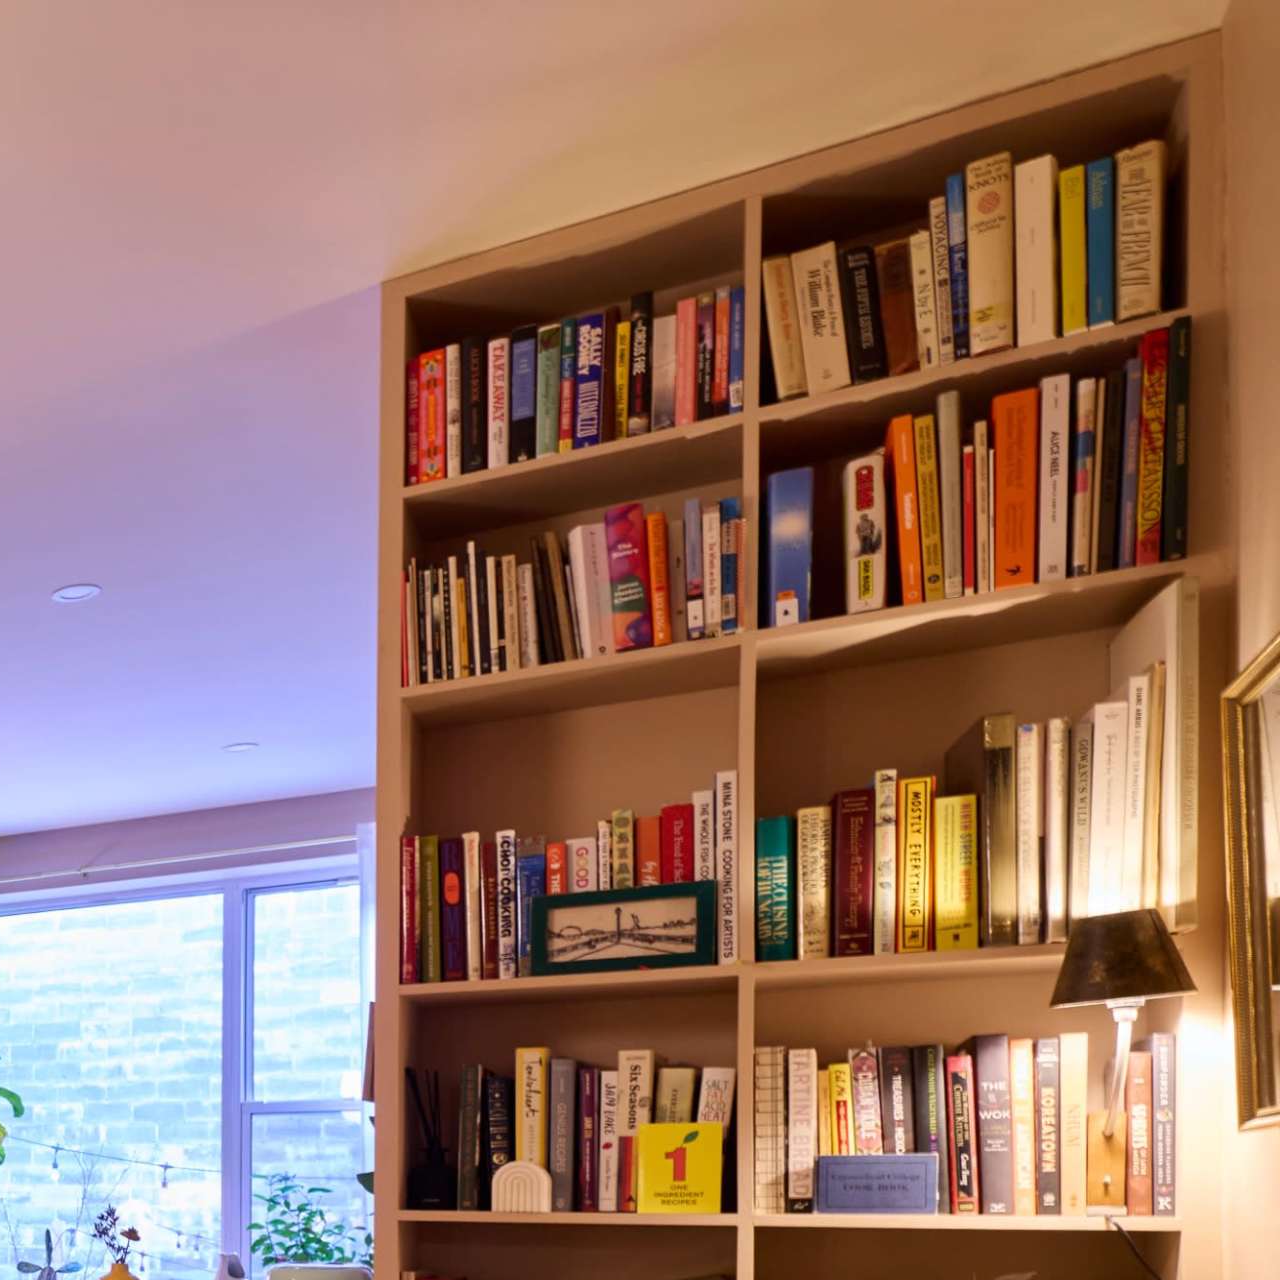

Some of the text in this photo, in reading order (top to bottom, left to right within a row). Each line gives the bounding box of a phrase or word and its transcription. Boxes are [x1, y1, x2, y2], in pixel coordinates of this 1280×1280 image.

[969, 174, 1009, 192] KNOTS
[1121, 181, 1152, 216] YEAR
[934, 212, 947, 277] VOYAGING
[1120, 231, 1152, 287] FRENCH
[807, 269, 826, 338] William Blake
[856, 288, 870, 315] FIFTH
[577, 324, 590, 375] ROONEY
[590, 327, 602, 366] SALLY
[493, 344, 505, 423] TAKEAWAY
[577, 381, 600, 437] INTERMEZZO
[1050, 431, 1060, 478] ALICE NEEL
[1141, 416, 1164, 538] KJARTANSSON
[1077, 739, 1088, 826] GOWANUS WILD
[673, 819, 682, 835] The
[700, 803, 709, 816] THE
[700, 819, 709, 845] WHOLE
[722, 782, 732, 842] MINA STONE
[576, 848, 589, 888] GOOD
[673, 837, 682, 857] Food
[700, 848, 709, 863] FISH
[909, 791, 922, 917] MOSTLY EVERYTHING
[960, 832, 973, 866] STREET
[501, 878, 511, 938] COOKING
[722, 849, 733, 958] COOKING FOR ARTISTS
[758, 881, 771, 939] HUNGARY
[772, 863, 788, 938] THE CUISINE
[627, 1064, 641, 1130] Six Seasons
[704, 1102, 726, 1112] ACID
[705, 1080, 729, 1090] SALT
[892, 1075, 903, 1120] TREASURES
[981, 1081, 1007, 1091] THE
[604, 1083, 616, 1136] JAM BAKE
[701, 1112, 727, 1121] HEAT
[792, 1053, 811, 1196] TARTINE BREAD
[955, 1116, 964, 1147] KITCHEN
[979, 1110, 1011, 1119] WOK
[1041, 1088, 1055, 1173] KOREATOWN
[556, 1103, 566, 1173] GENIUS RECIPES
[665, 1146, 686, 1182] 1
